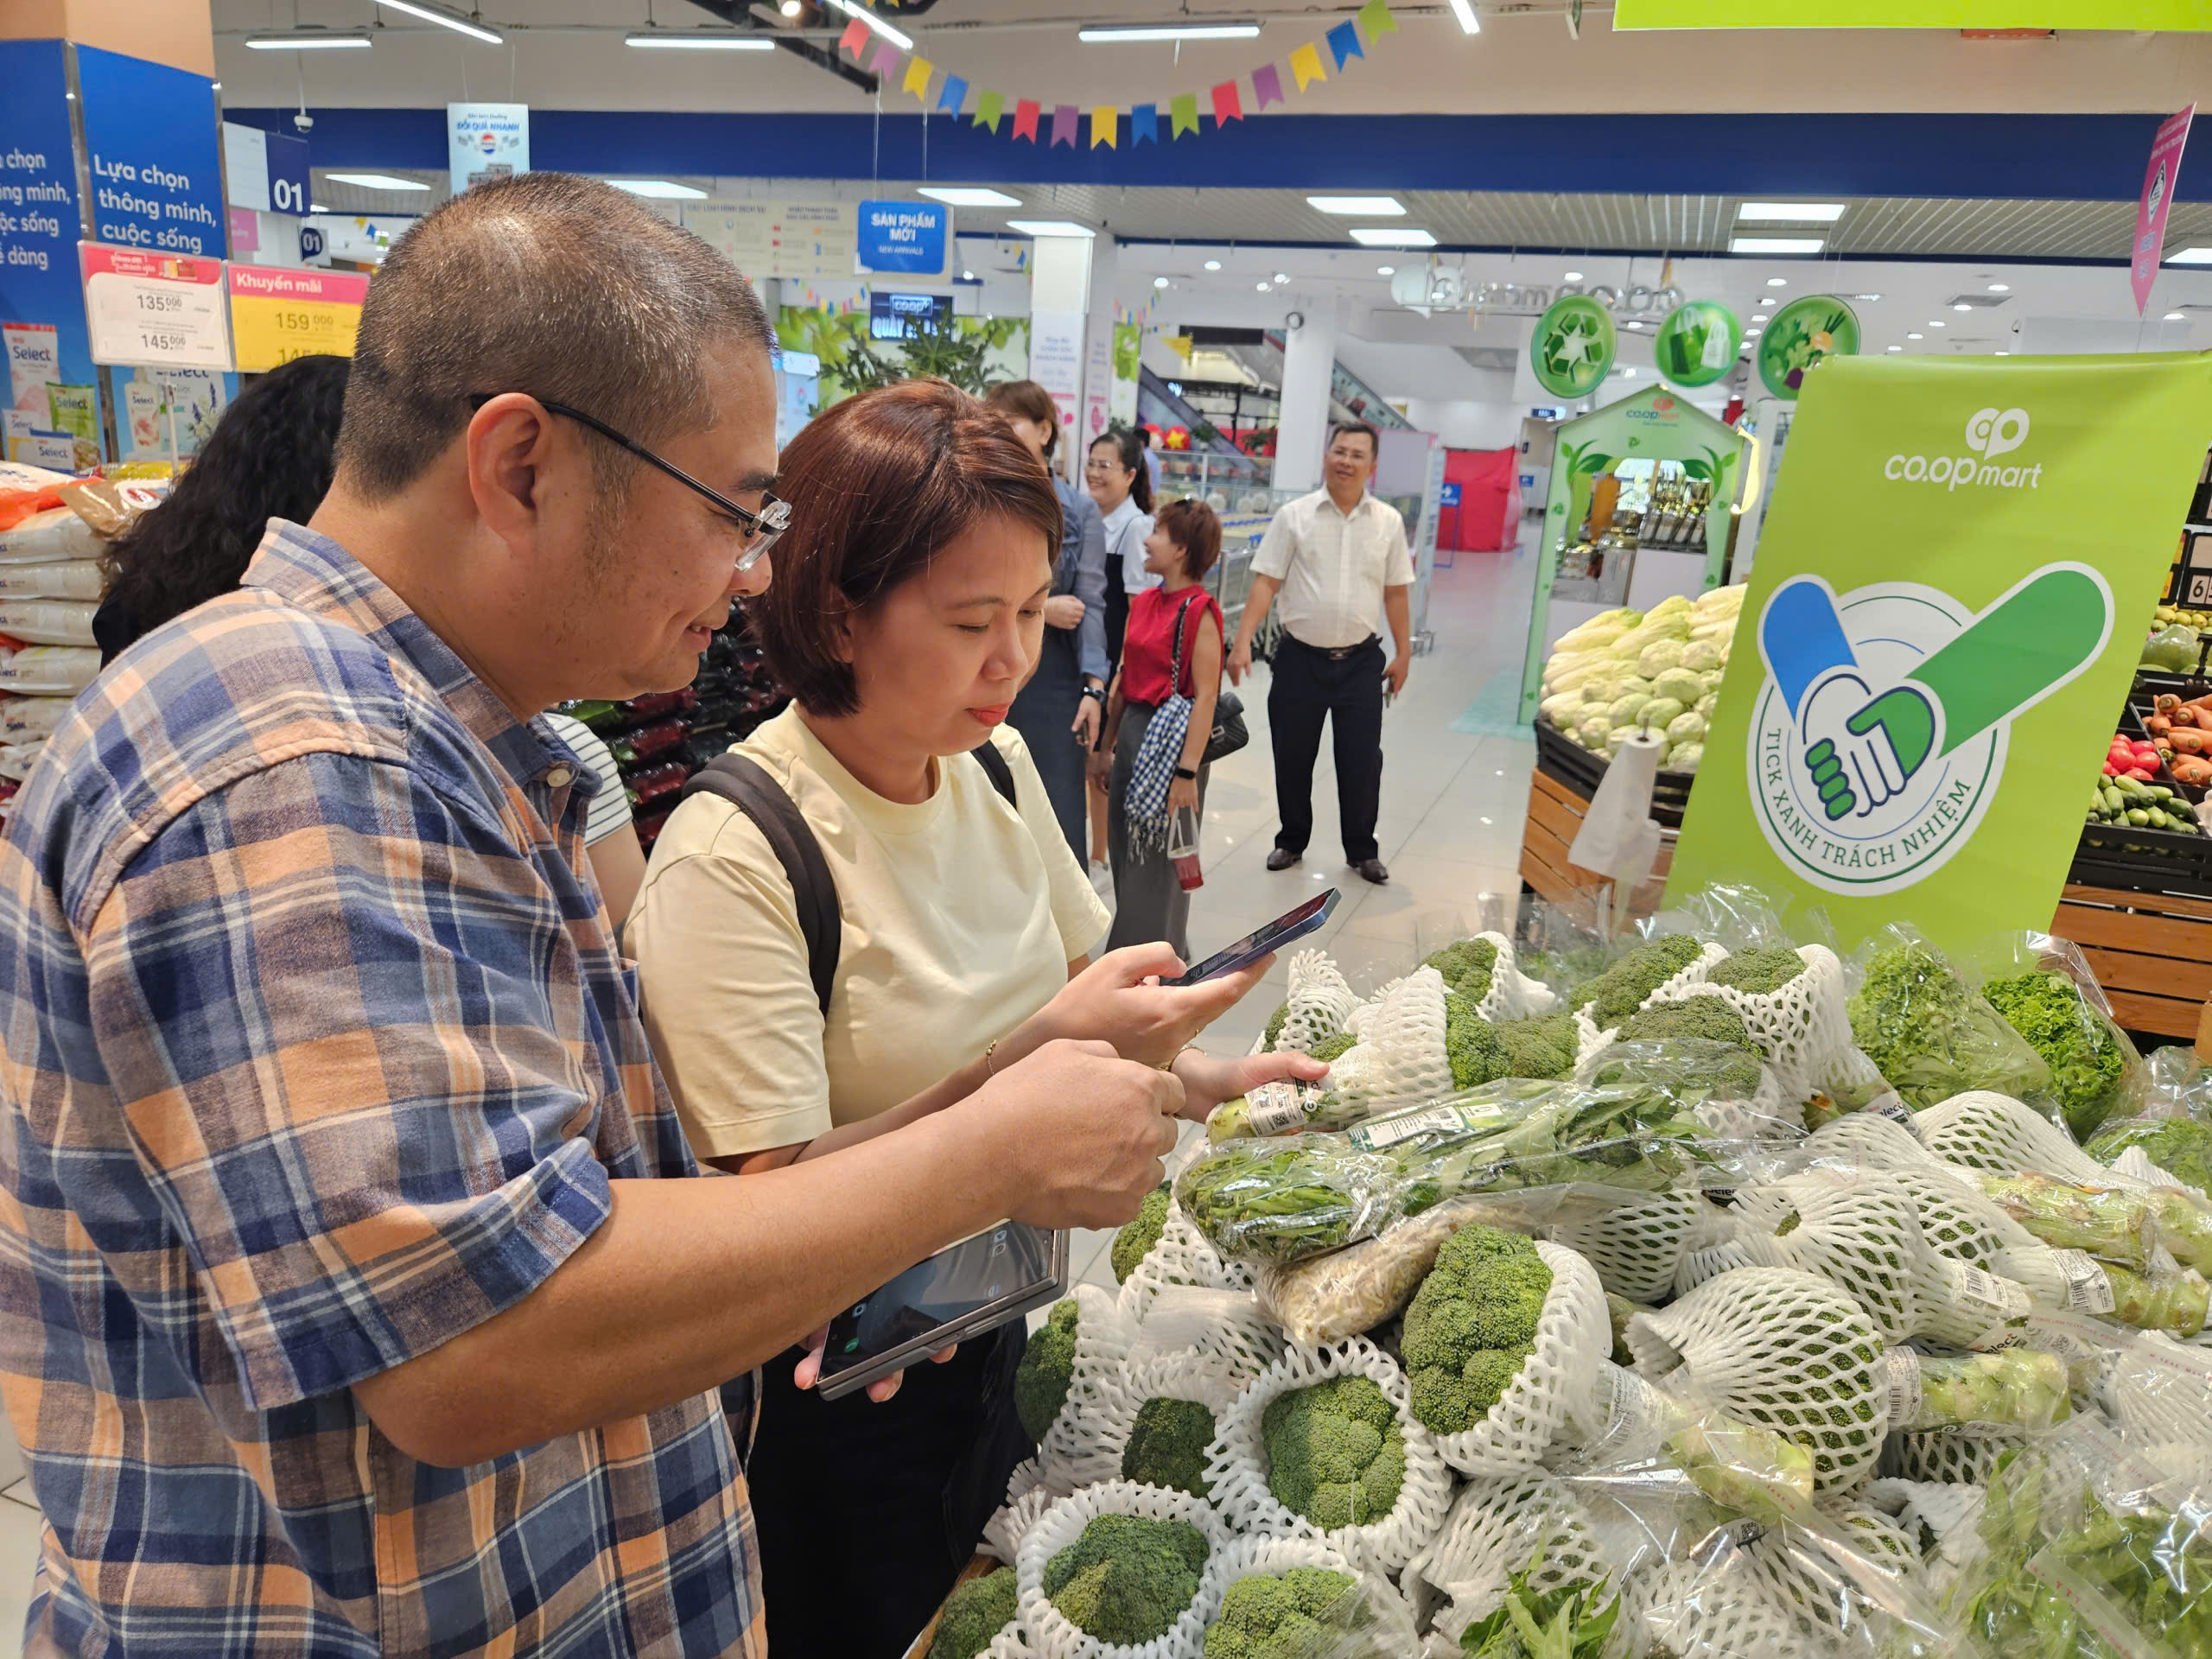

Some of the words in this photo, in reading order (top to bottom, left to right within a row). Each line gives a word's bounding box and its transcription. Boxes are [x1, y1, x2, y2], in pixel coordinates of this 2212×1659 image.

[7, 147, 47, 175] chọn
[93, 153, 136, 183] Lựa
[141, 163, 190, 193] chọn
[26, 180, 71, 206] minh,
[274, 178, 303, 213] 01
[99, 188, 160, 220] thông
[165, 200, 217, 228] minh,
[21, 210, 60, 238] sống
[102, 222, 152, 248] cuộc
[156, 226, 203, 255] sống
[302, 233, 321, 252] 01
[8, 243, 48, 270] dàng
[236, 273, 294, 292] Khuyến
[296, 279, 322, 293] mãi
[13, 346, 52, 361] Select
[56, 396, 88, 410] Select
[131, 396, 154, 404] Select
[39, 447, 68, 459] Select
[1885, 454, 2043, 492] co.opmart
[1765, 728, 1783, 786] TICK
[1773, 789, 1818, 851] XANH
[1901, 779, 1972, 857] NHIỆM
[1822, 841, 1897, 868] TRÁCH
